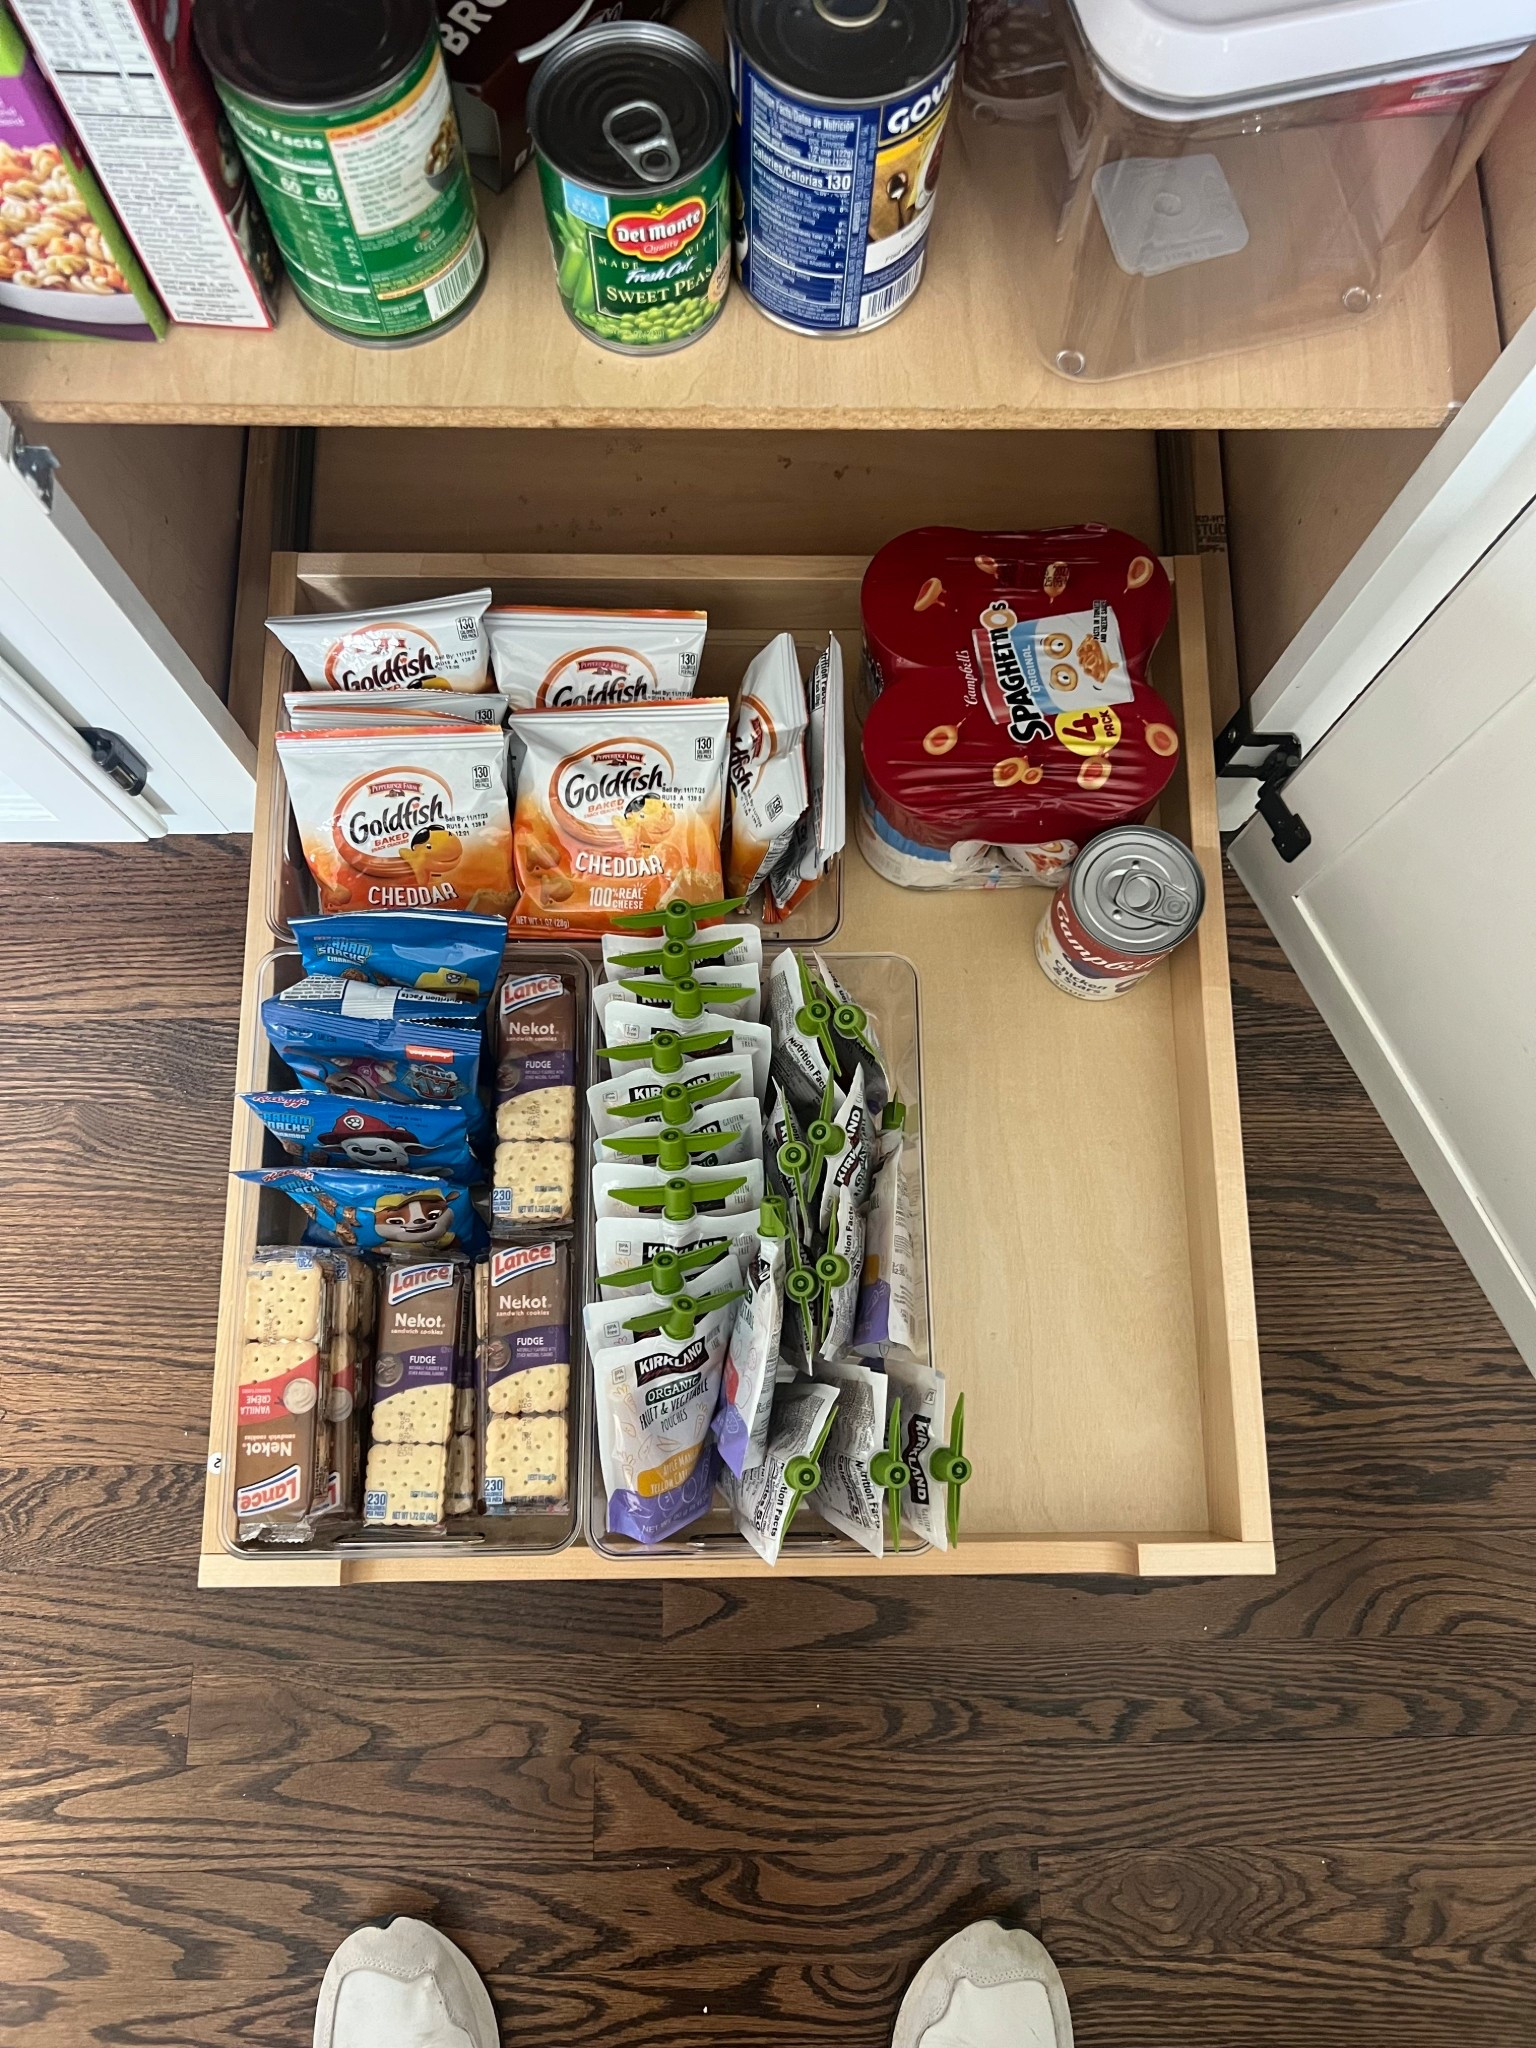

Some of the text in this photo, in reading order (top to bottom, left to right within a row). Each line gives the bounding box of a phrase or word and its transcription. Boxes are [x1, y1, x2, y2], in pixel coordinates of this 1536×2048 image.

[439, 0, 507, 56] BR
[825, 175, 851, 190] 130
[315, 186, 339, 201] 60
[616, 208, 701, 243] Del Monte
[598, 229, 715, 270] MADE WITH
[643, 239, 679, 254] Quality
[606, 286, 670, 304] SWEET
[674, 264, 712, 297] PEAS
[458, 617, 474, 630] 130
[681, 653, 696, 665] 130
[342, 646, 434, 691] Goldfish
[1022, 644, 1041, 693] ORIGINAL
[552, 675, 648, 707] Goldfish
[477, 709, 492, 720] 130
[1062, 713, 1099, 741] 4
[1099, 710, 1117, 738] PACK
[696, 737, 712, 749] 130
[473, 766, 488, 778] 130
[565, 764, 663, 808] Goldfish
[587, 798, 625, 813] BAKED
[349, 796, 444, 844] Goldfish
[374, 832, 409, 847] BAKED
[575, 850, 664, 879] CHEDDAR
[368, 882, 459, 907] CHEDDAR
[619, 886, 644, 900] REAL
[612, 899, 644, 910] CHEESE
[515, 915, 527, 925] NET
[528, 916, 538, 926] WT
[1054, 959, 1108, 990] Chicken
[504, 977, 558, 1005] Lance
[1064, 975, 1101, 994] Stars
[509, 1021, 556, 1035] Nekot
[525, 1060, 551, 1069] FUDGE
[787, 1036, 827, 1092] Nutrition Fact
[266, 1121, 311, 1133] NACKS
[493, 1189, 511, 1201] 230
[495, 1245, 552, 1276] Lance
[393, 1266, 450, 1294] Lance
[499, 1294, 548, 1310] Nekot
[395, 1312, 442, 1328] Nekot
[516, 1336, 544, 1345] FUDGE
[409, 1355, 437, 1364] FUDGE
[640, 1341, 703, 1375] KIRKLAND
[648, 1376, 699, 1402] ORGANIC
[240, 1405, 271, 1415] VANILLA
[639, 1405, 659, 1431] FRUIT
[660, 1402, 668, 1415] &
[660, 1407, 688, 1433] POUCHES
[246, 1441, 293, 1457] Nekot
[908, 1420, 928, 1500] KIRKLAND
[485, 1479, 503, 1491] 230
[240, 1477, 298, 1512] Lance
[368, 1494, 386, 1505] 230
